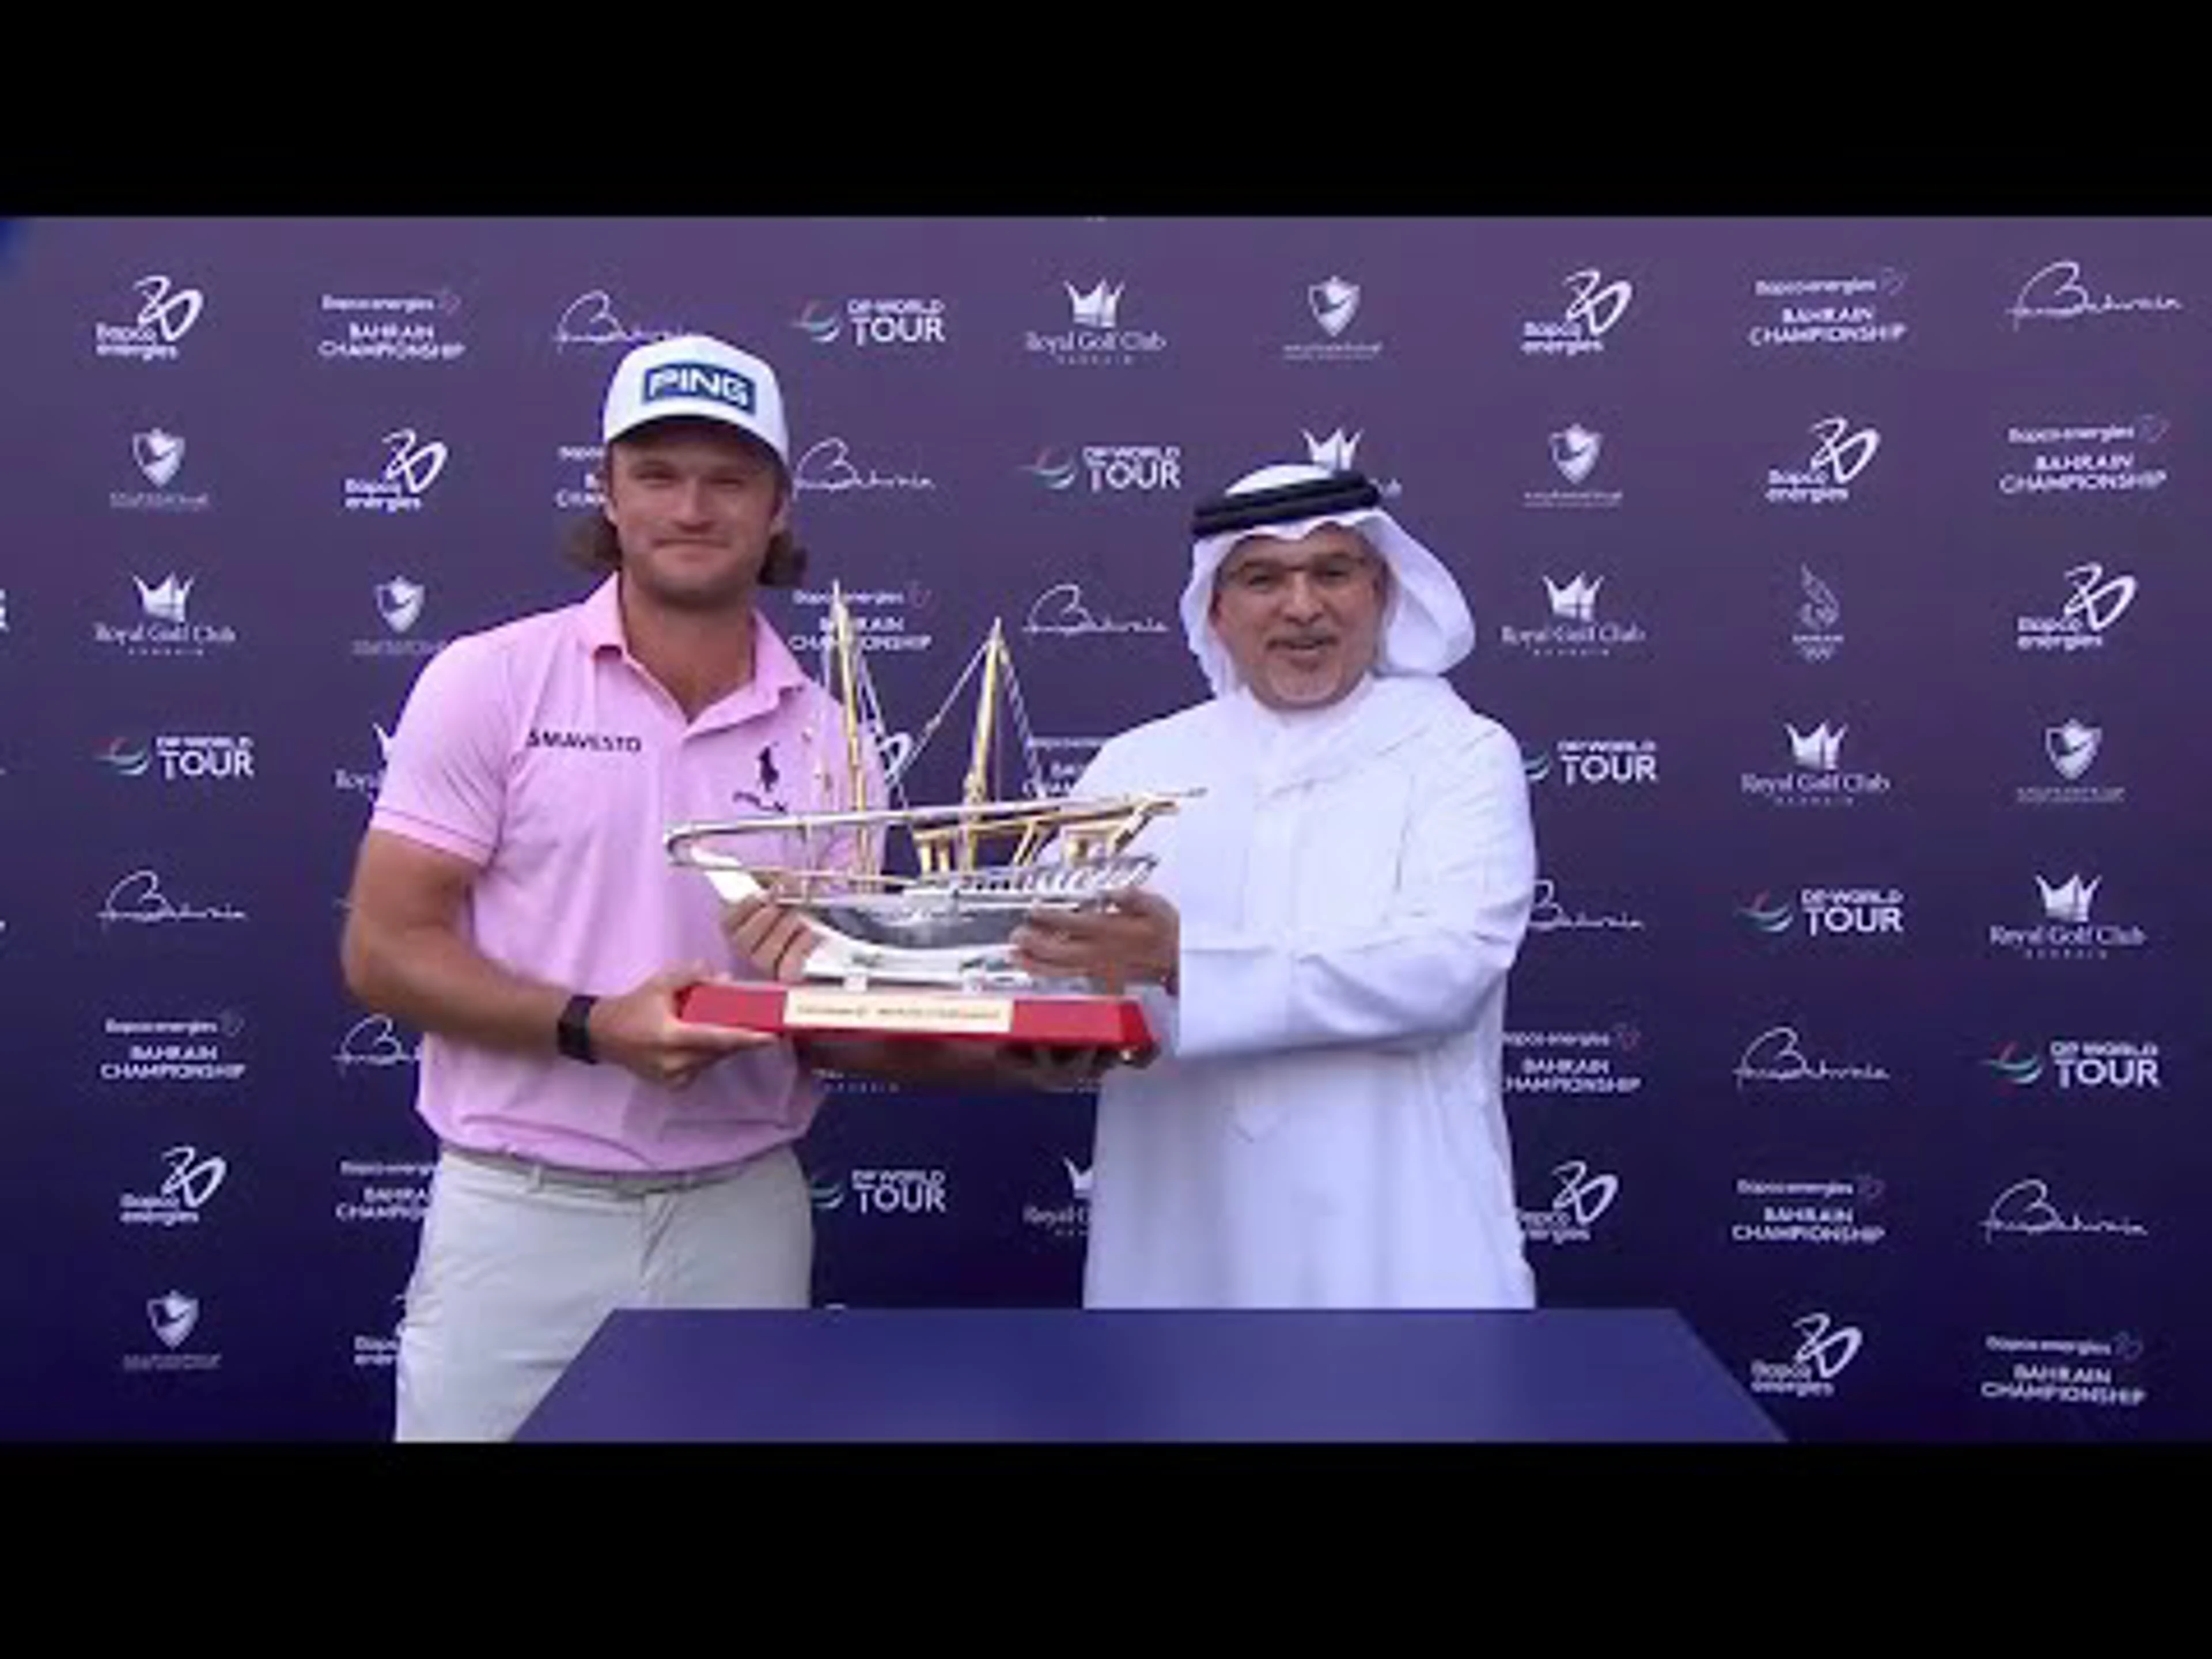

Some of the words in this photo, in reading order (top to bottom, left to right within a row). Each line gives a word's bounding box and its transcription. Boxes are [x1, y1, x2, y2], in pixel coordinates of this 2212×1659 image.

[850, 316, 946, 345] TOUR
[649, 369, 749, 407] PING
[1086, 462, 1181, 493] TOUR
[159, 749, 254, 779] TOUR
[1561, 755, 1657, 784] TOUR
[1804, 907, 1903, 937] TOUR
[1505, 1078, 1642, 1093] HAMPIONSHIP
[2054, 1058, 2161, 1088] TOUR
[855, 1184, 946, 1213] TOUR
